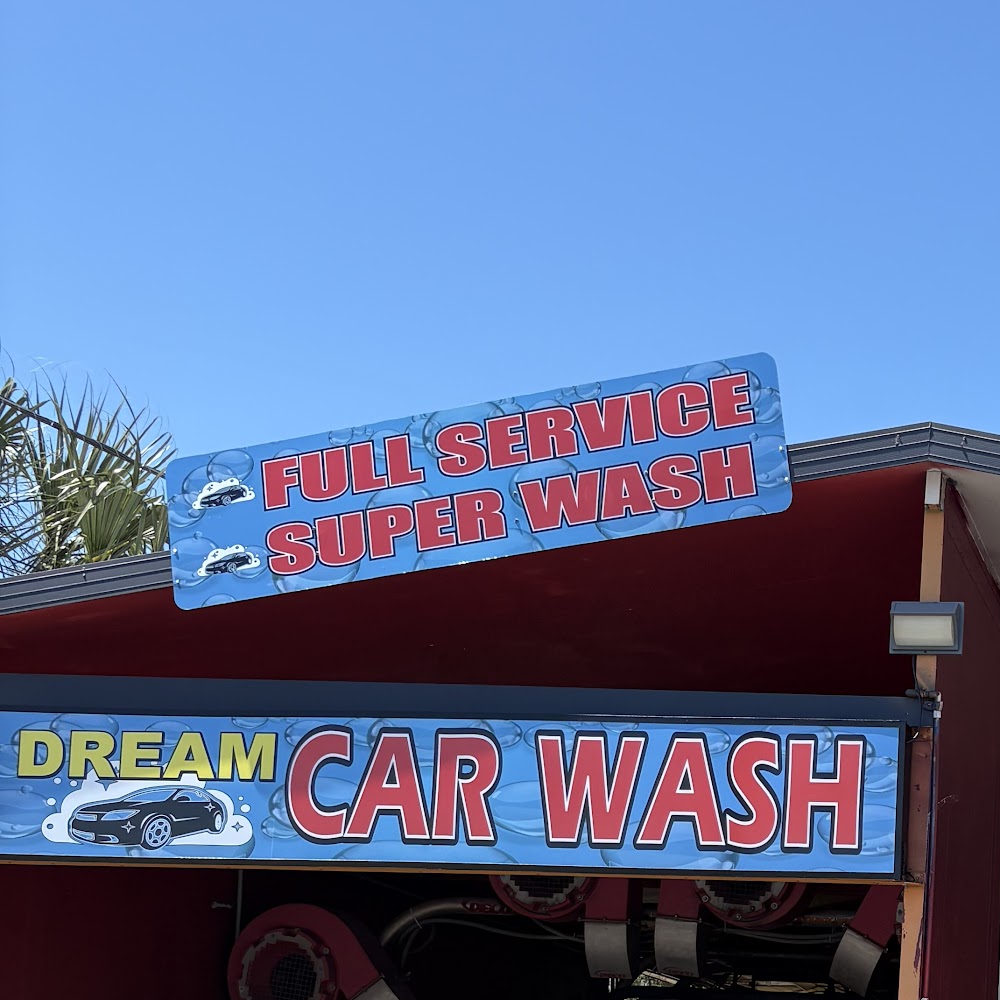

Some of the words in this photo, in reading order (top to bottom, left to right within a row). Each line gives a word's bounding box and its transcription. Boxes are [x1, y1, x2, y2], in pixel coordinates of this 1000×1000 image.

[261, 434, 425, 512] FULL
[436, 371, 756, 477] SERVICE
[265, 487, 507, 578] SUPER
[517, 442, 760, 535] WASH
[16, 729, 278, 783] DREAM
[283, 725, 503, 847] CAR
[536, 727, 866, 856] WASH
